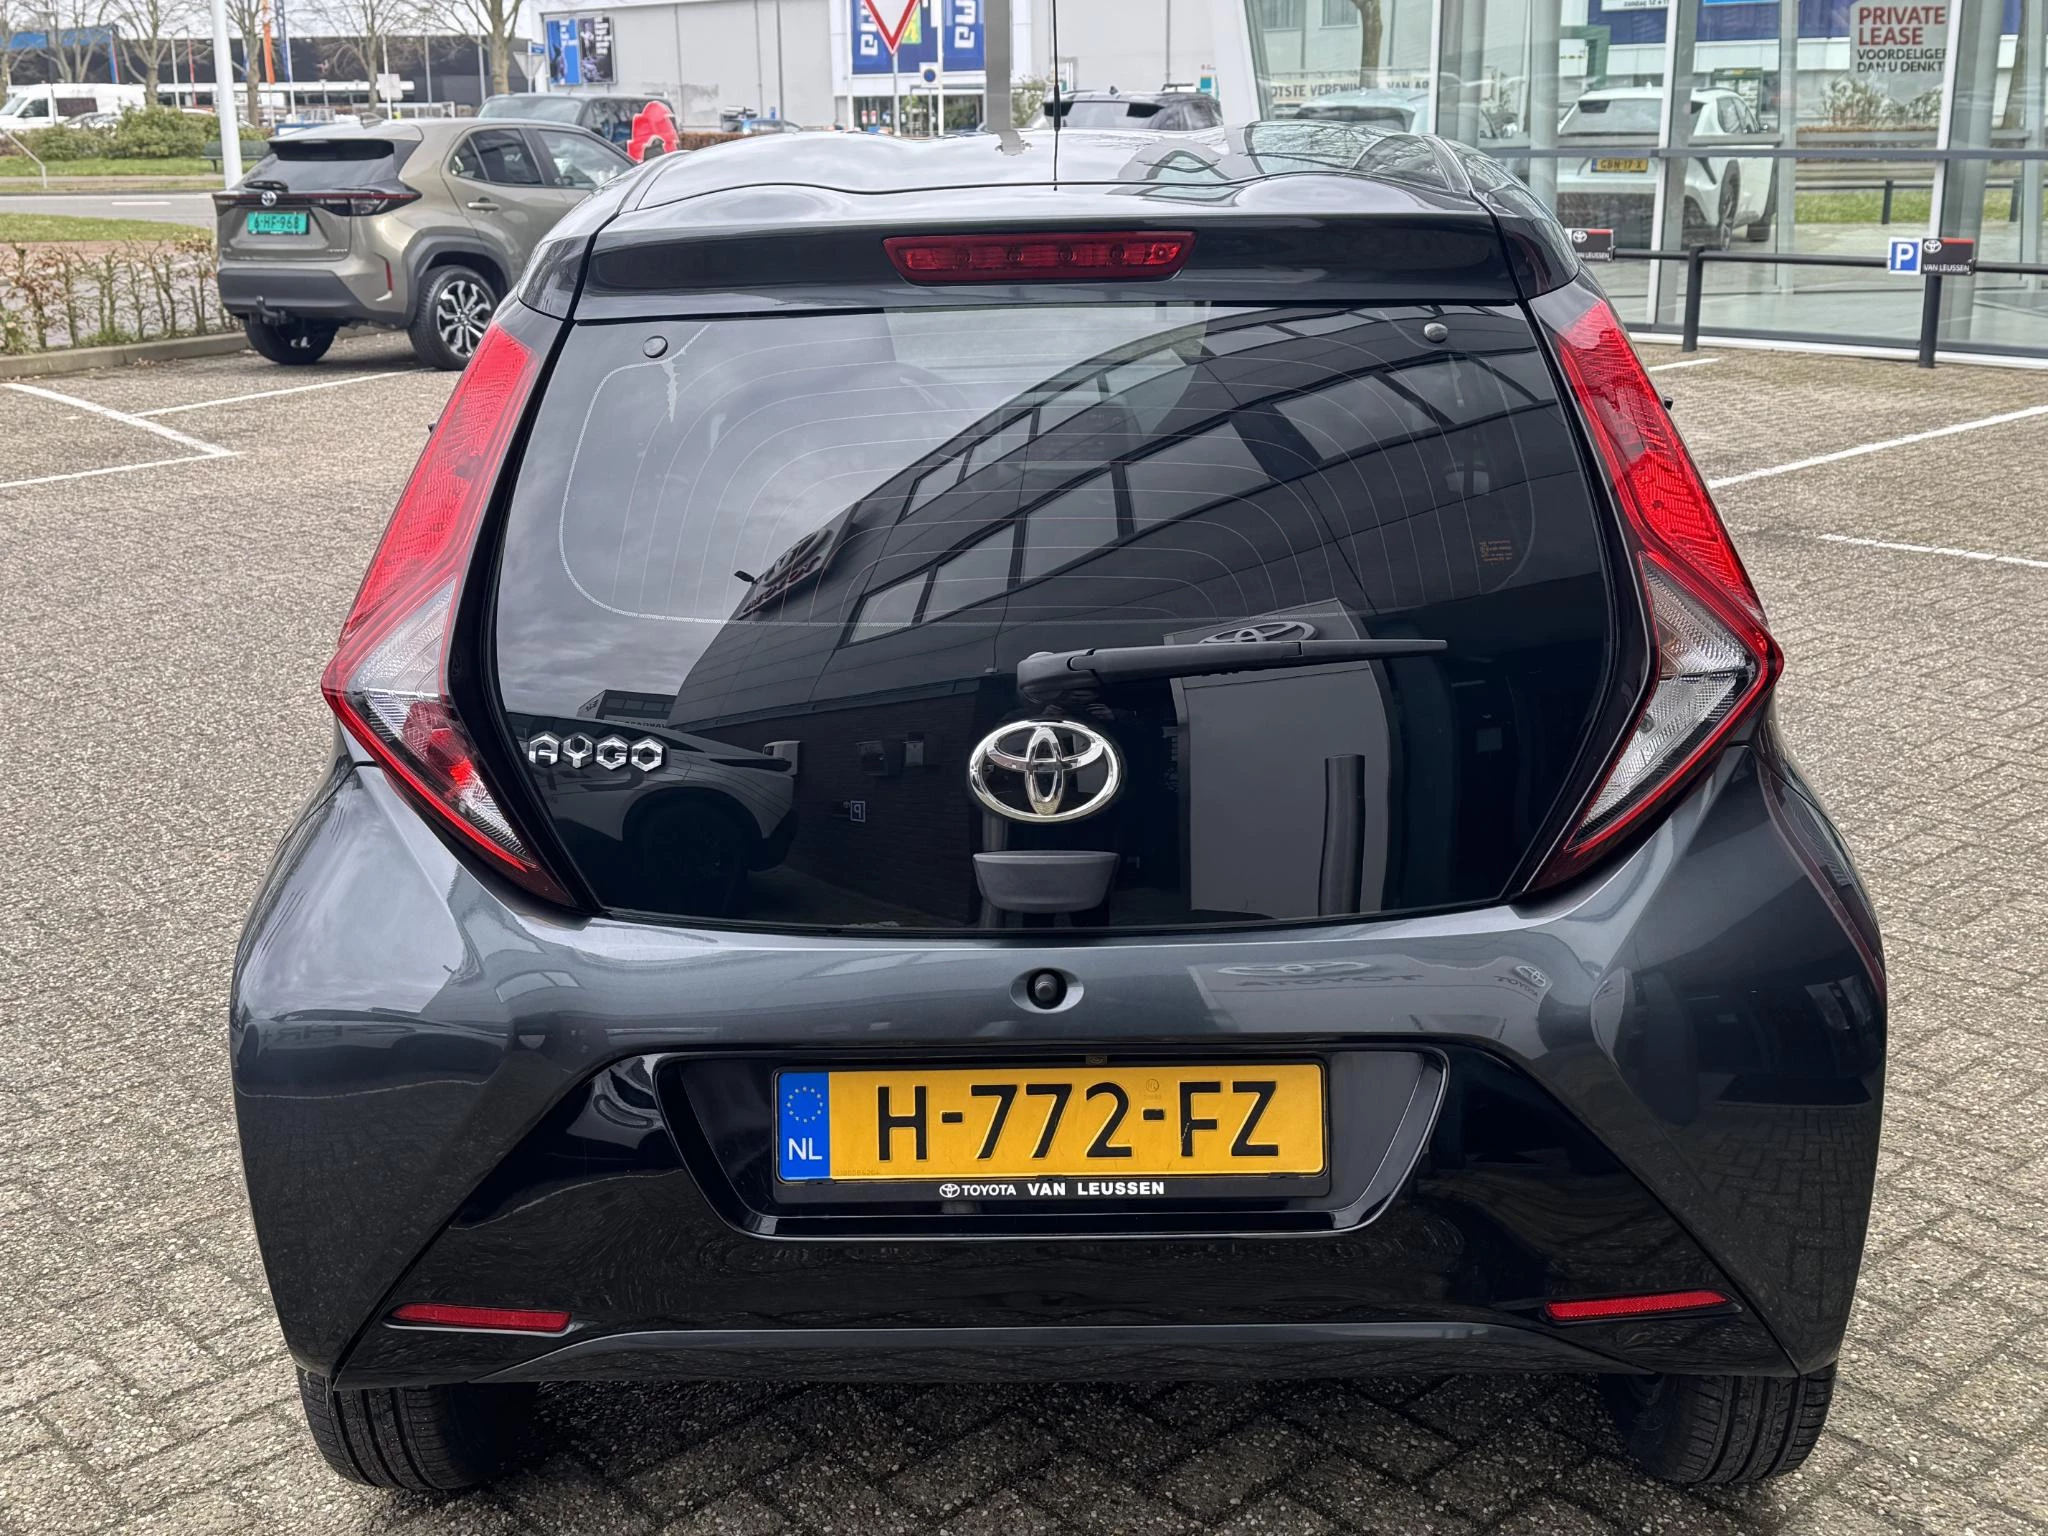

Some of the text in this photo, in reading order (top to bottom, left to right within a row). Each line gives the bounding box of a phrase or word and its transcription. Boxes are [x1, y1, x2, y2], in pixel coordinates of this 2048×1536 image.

[1859, 6, 1946, 25] PRIVATE
[1859, 27, 1924, 45] LEASE
[1857, 61, 1945, 73] DAN U DENKT
[1896, 243, 1914, 269] P
[1939, 264, 1970, 272] LEUSSEN
[529, 733, 664, 772] AYGO
[876, 1081, 1279, 1161] H-772-FZ
[788, 1137, 823, 1161] NL
[962, 1181, 1165, 1196] TOYOTA VAN LEUSSEN
